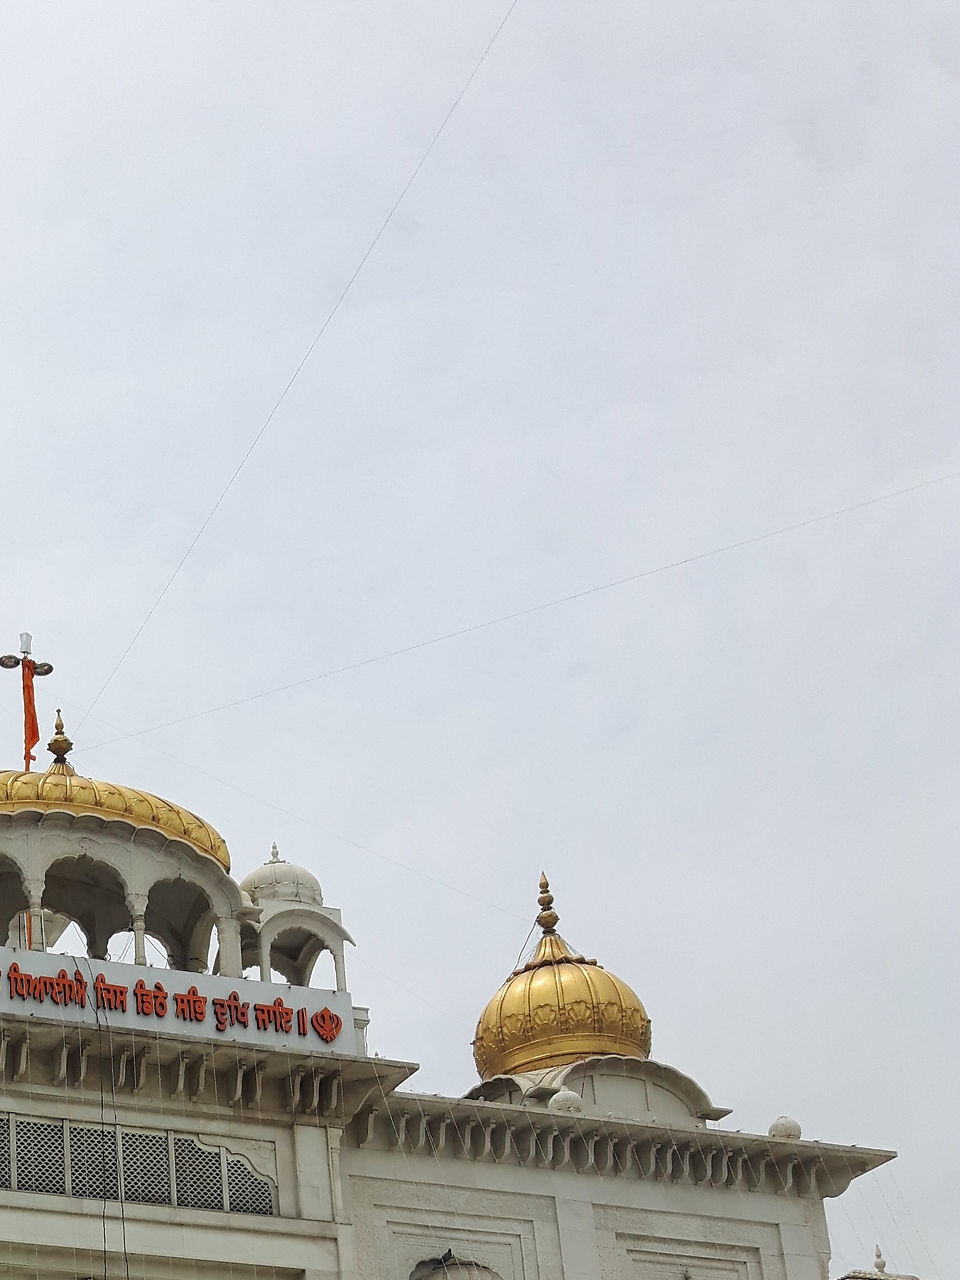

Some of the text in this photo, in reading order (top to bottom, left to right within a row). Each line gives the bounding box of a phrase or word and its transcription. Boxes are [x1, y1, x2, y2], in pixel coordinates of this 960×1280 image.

[8, 961, 88, 1008] ਧਿਆਈਐ
[94, 973, 129, 1013] ਜਿਸ
[174, 985, 208, 1022] ਸਭਿ
[213, 991, 249, 1031] ਦੁਖਿ
[254, 997, 294, 1034] ਜਾਇ
